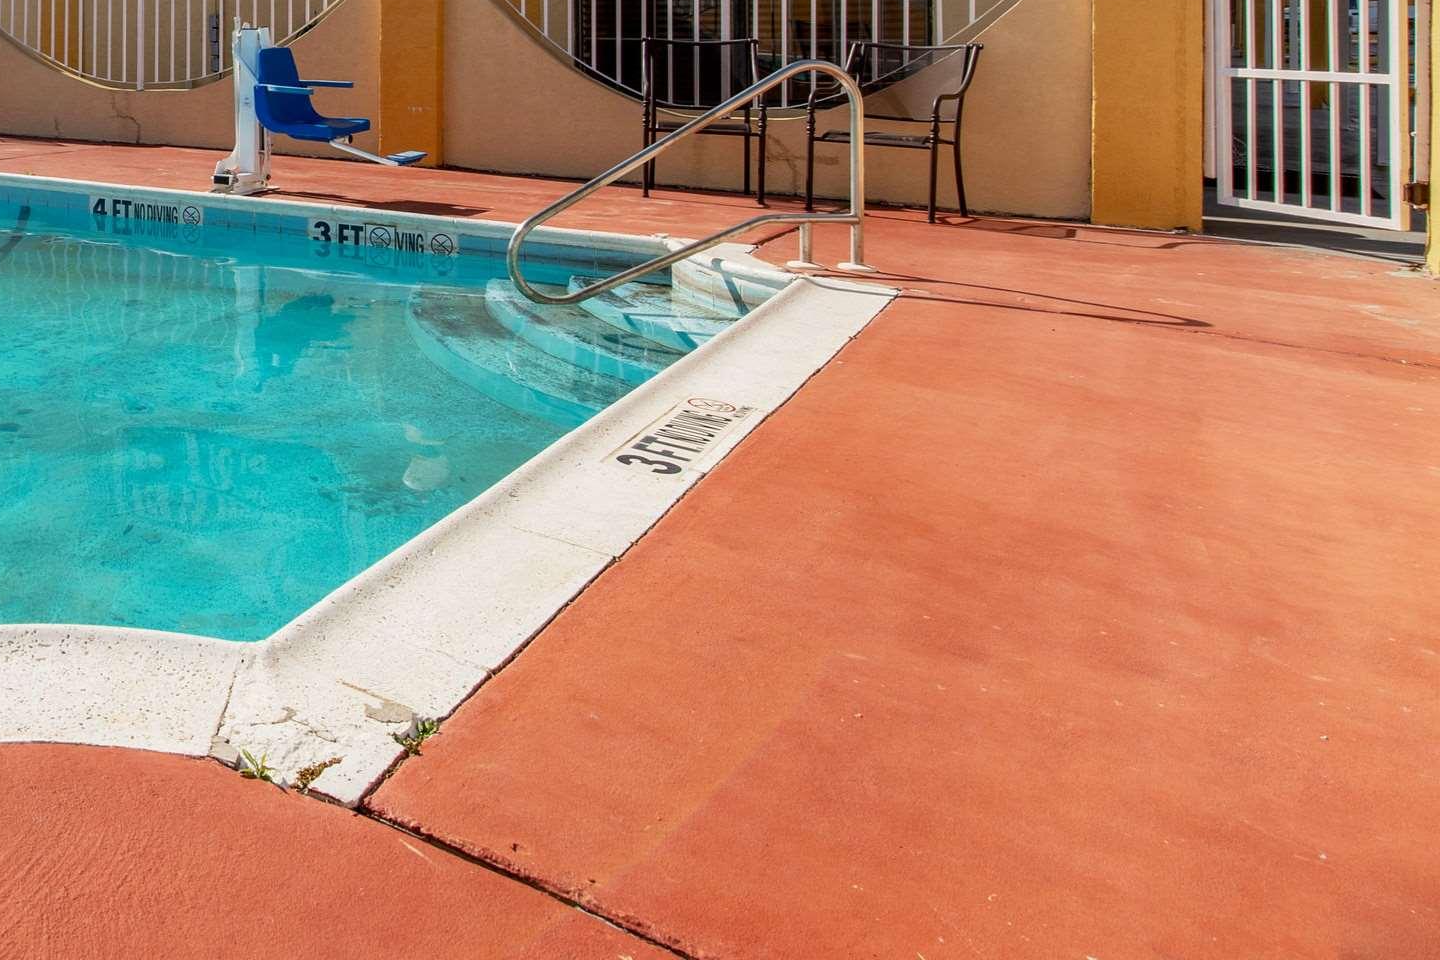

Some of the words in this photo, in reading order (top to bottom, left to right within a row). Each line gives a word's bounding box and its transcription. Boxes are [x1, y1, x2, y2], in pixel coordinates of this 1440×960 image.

[93, 198, 107, 216] 4
[113, 199, 132, 219] FT
[134, 203, 145, 220] NO
[147, 204, 178, 224] DIVING
[314, 221, 331, 243] 3
[338, 223, 363, 245] FT
[632, 435, 701, 462] FT
[616, 455, 682, 474] 3
